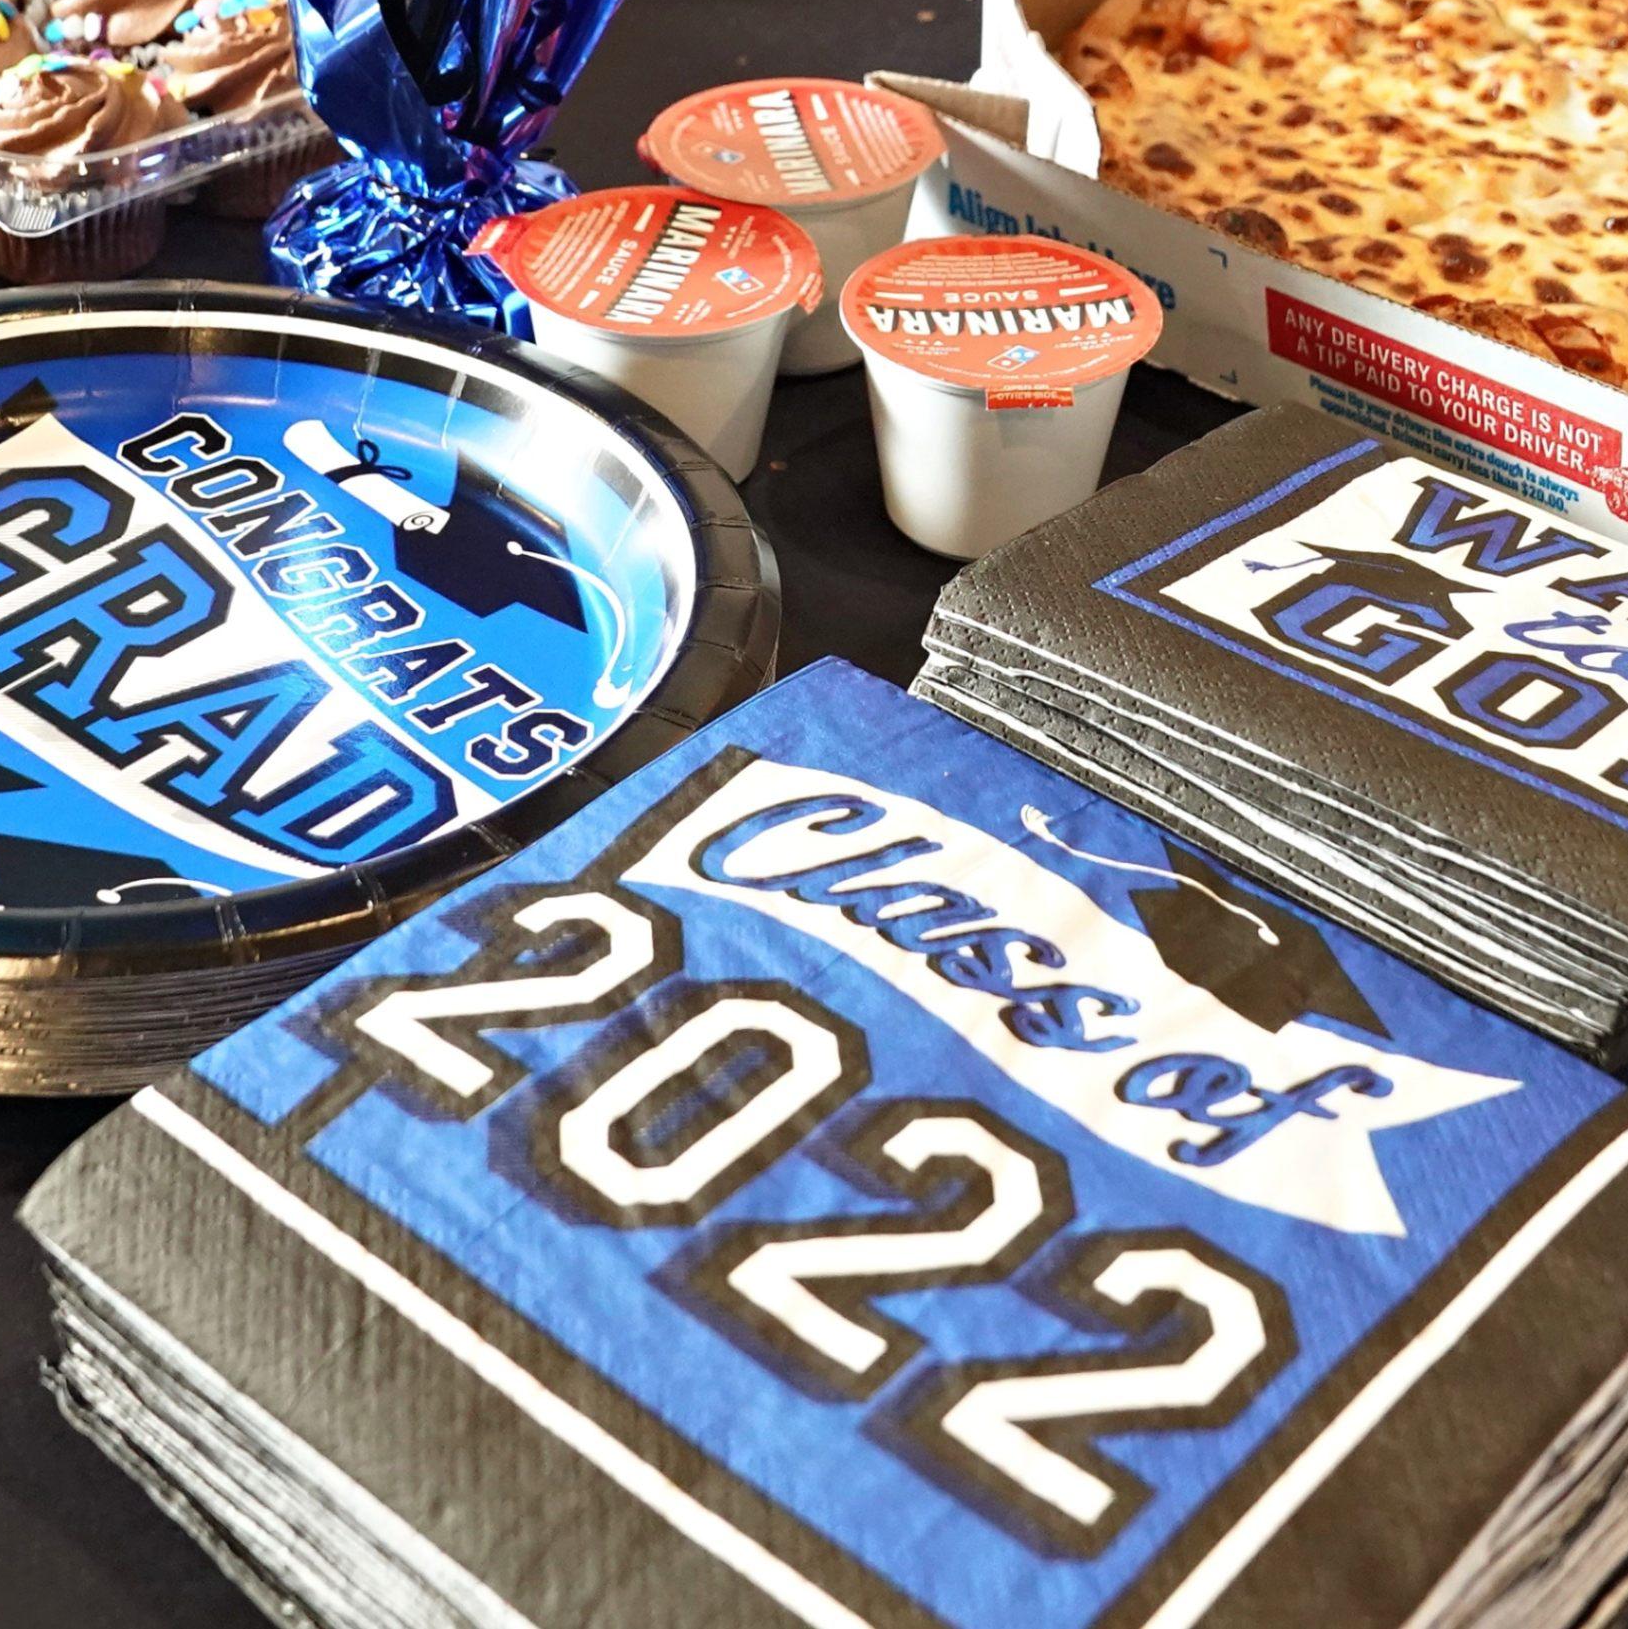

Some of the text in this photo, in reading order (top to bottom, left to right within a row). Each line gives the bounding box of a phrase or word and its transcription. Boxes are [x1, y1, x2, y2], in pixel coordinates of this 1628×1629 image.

[594, 238, 639, 287] SAUCE
[601, 202, 723, 325] MARINARA
[865, 295, 1134, 337] MARINARA
[942, 290, 1039, 304] SAUCE
[1285, 307, 1604, 455] ANY DELIVERY CHARGE IS NOT
[1297, 336, 1591, 475] A TIP PAID TO YOUR DRIVER.
[1433, 425, 1453, 448] the
[1454, 437, 1485, 463] extra
[1485, 448, 1523, 481] dough
[1524, 466, 1537, 483] is
[1537, 471, 1580, 503] always
[1491, 465, 1520, 494] than
[116, 412, 595, 788] CONGRATS
[688, 793, 1396, 1164] Class of
[339, 877, 1291, 1552] 2022
